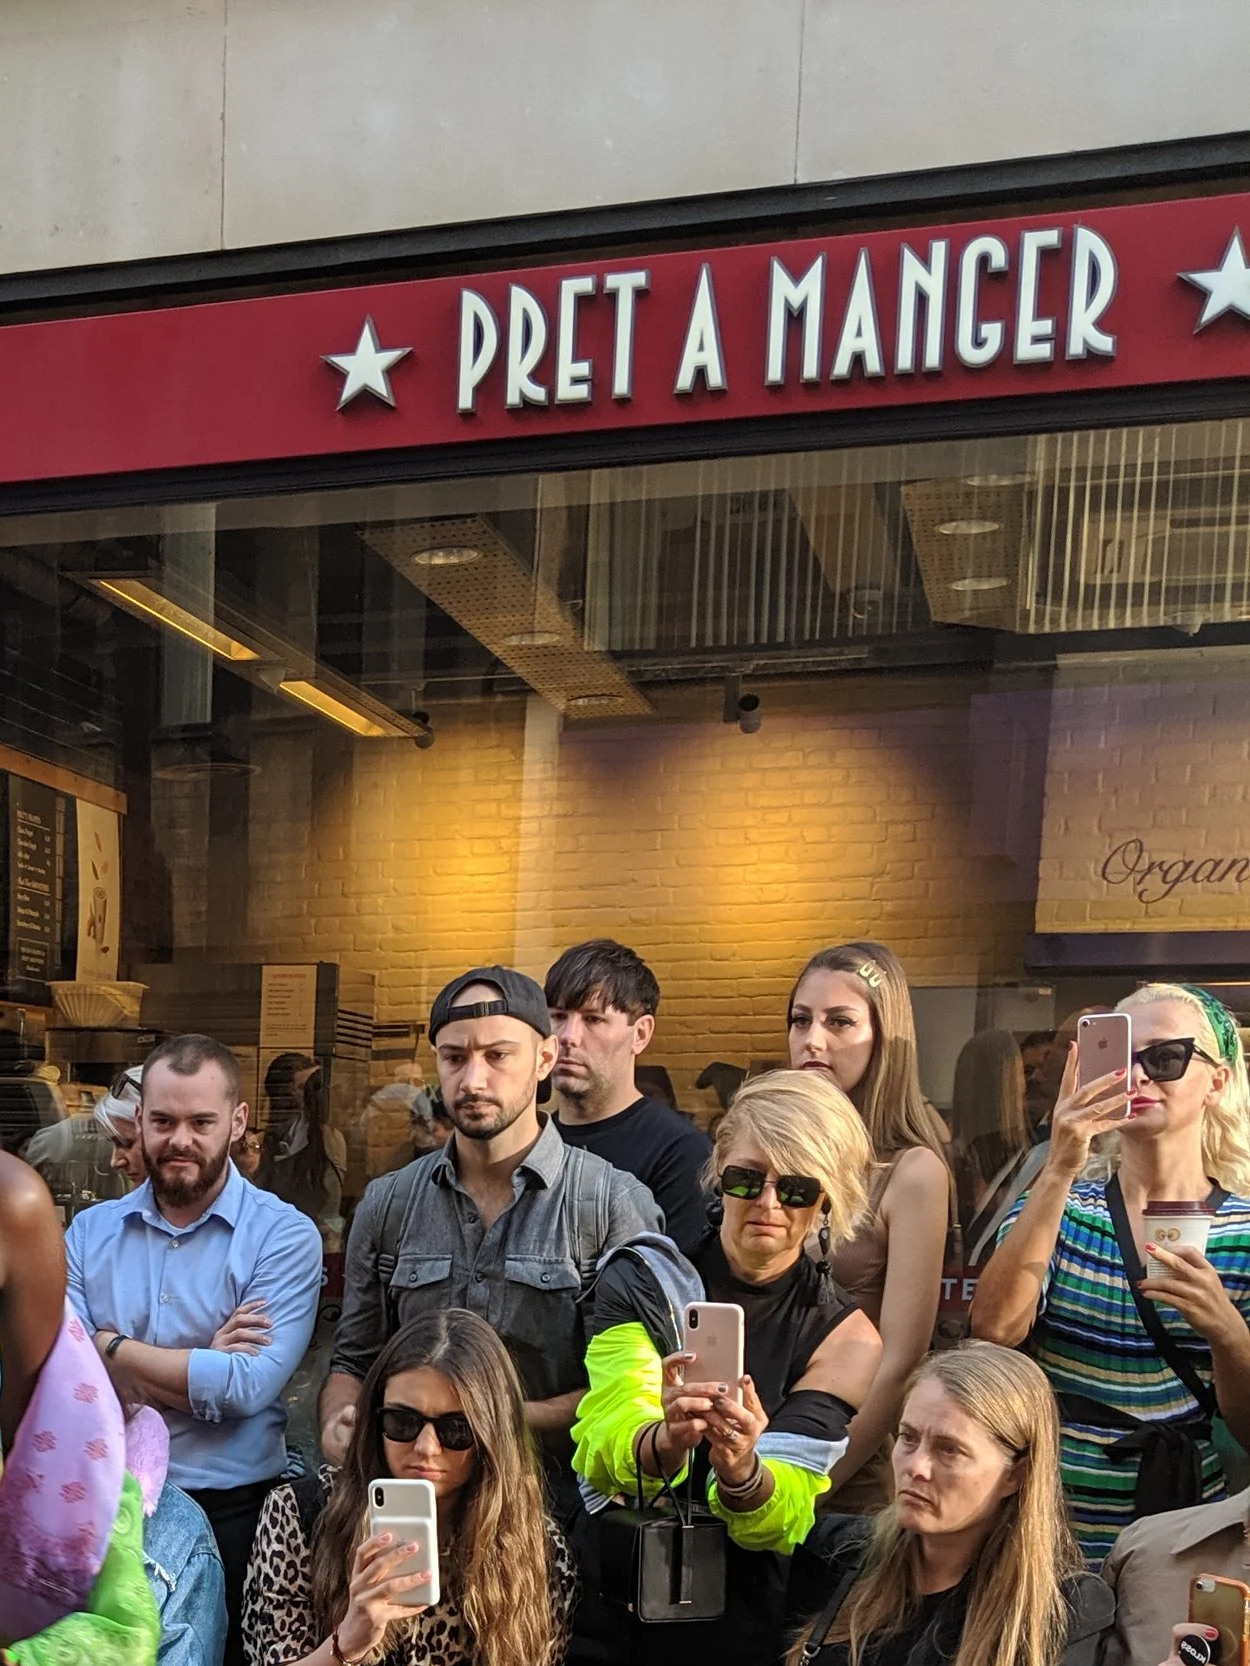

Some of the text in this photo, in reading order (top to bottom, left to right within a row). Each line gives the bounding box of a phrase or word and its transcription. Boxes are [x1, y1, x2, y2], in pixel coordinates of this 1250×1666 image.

[456, 224, 1119, 414] PRET A MANGER
[1101, 837, 1250, 905] Organ
